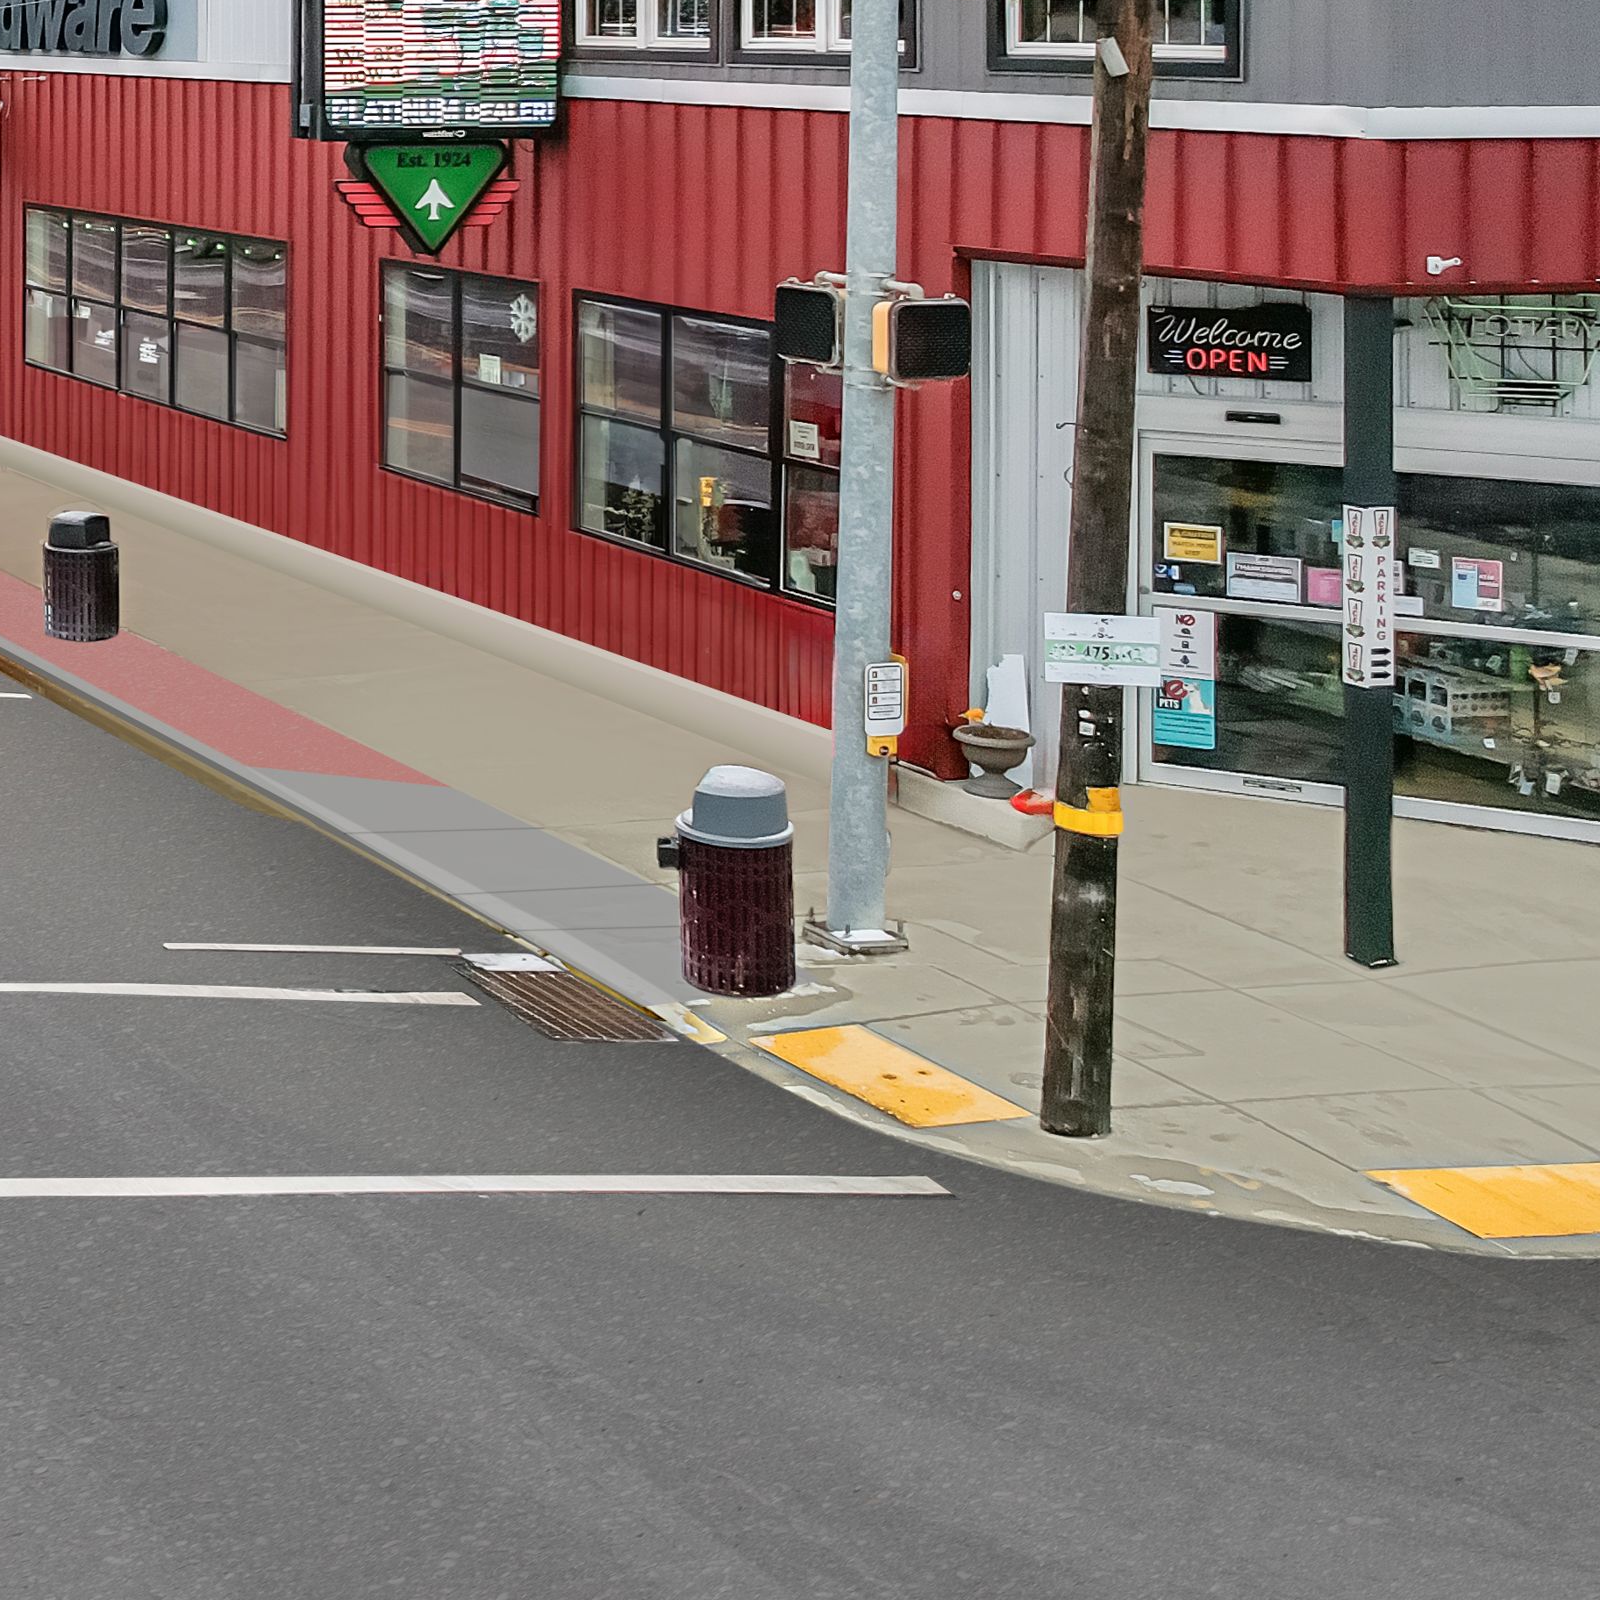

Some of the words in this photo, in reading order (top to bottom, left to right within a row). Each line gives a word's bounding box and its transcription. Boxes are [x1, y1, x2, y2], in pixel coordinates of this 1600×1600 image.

[396, 152, 429, 169] Est.
[433, 152, 471, 169] 1924
[1154, 314, 1303, 350] Welcome
[1186, 348, 1268, 373] OPEN
[1376, 555, 1387, 641] PARKING
[1159, 698, 1180, 709] PETS
